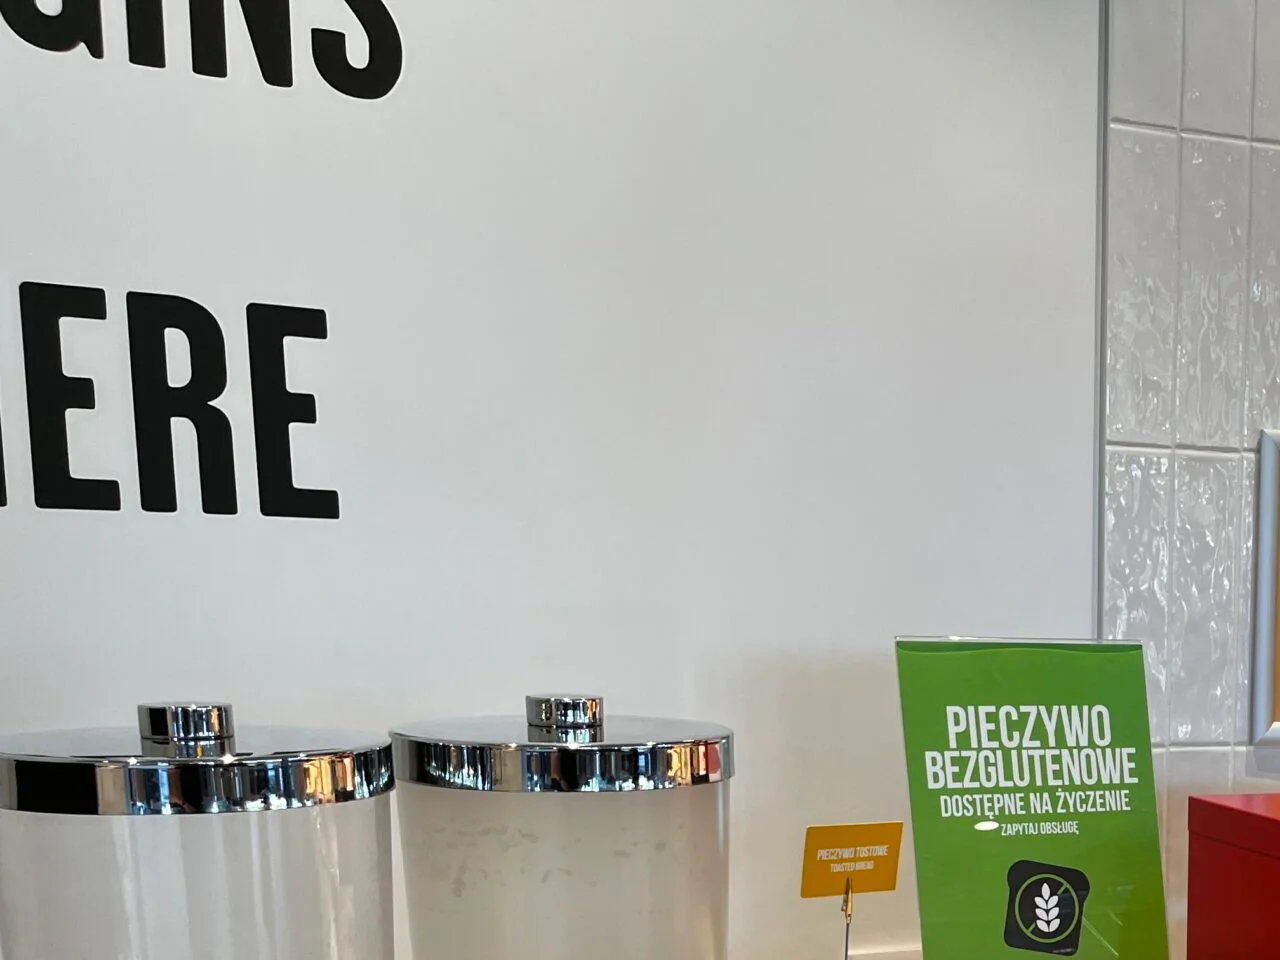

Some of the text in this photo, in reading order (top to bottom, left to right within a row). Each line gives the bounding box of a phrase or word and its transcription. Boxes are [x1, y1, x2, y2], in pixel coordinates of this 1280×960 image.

[0, 281, 341, 520] ERE
[946, 704, 1112, 749] PIECZYWO
[924, 747, 1139, 790] BEZGLUTENOWE
[940, 788, 1131, 820] DOSTĘPNE NA ŻYCZENIE
[1001, 821, 1079, 836] ZAPYTAJ OBSŁUGĘ
